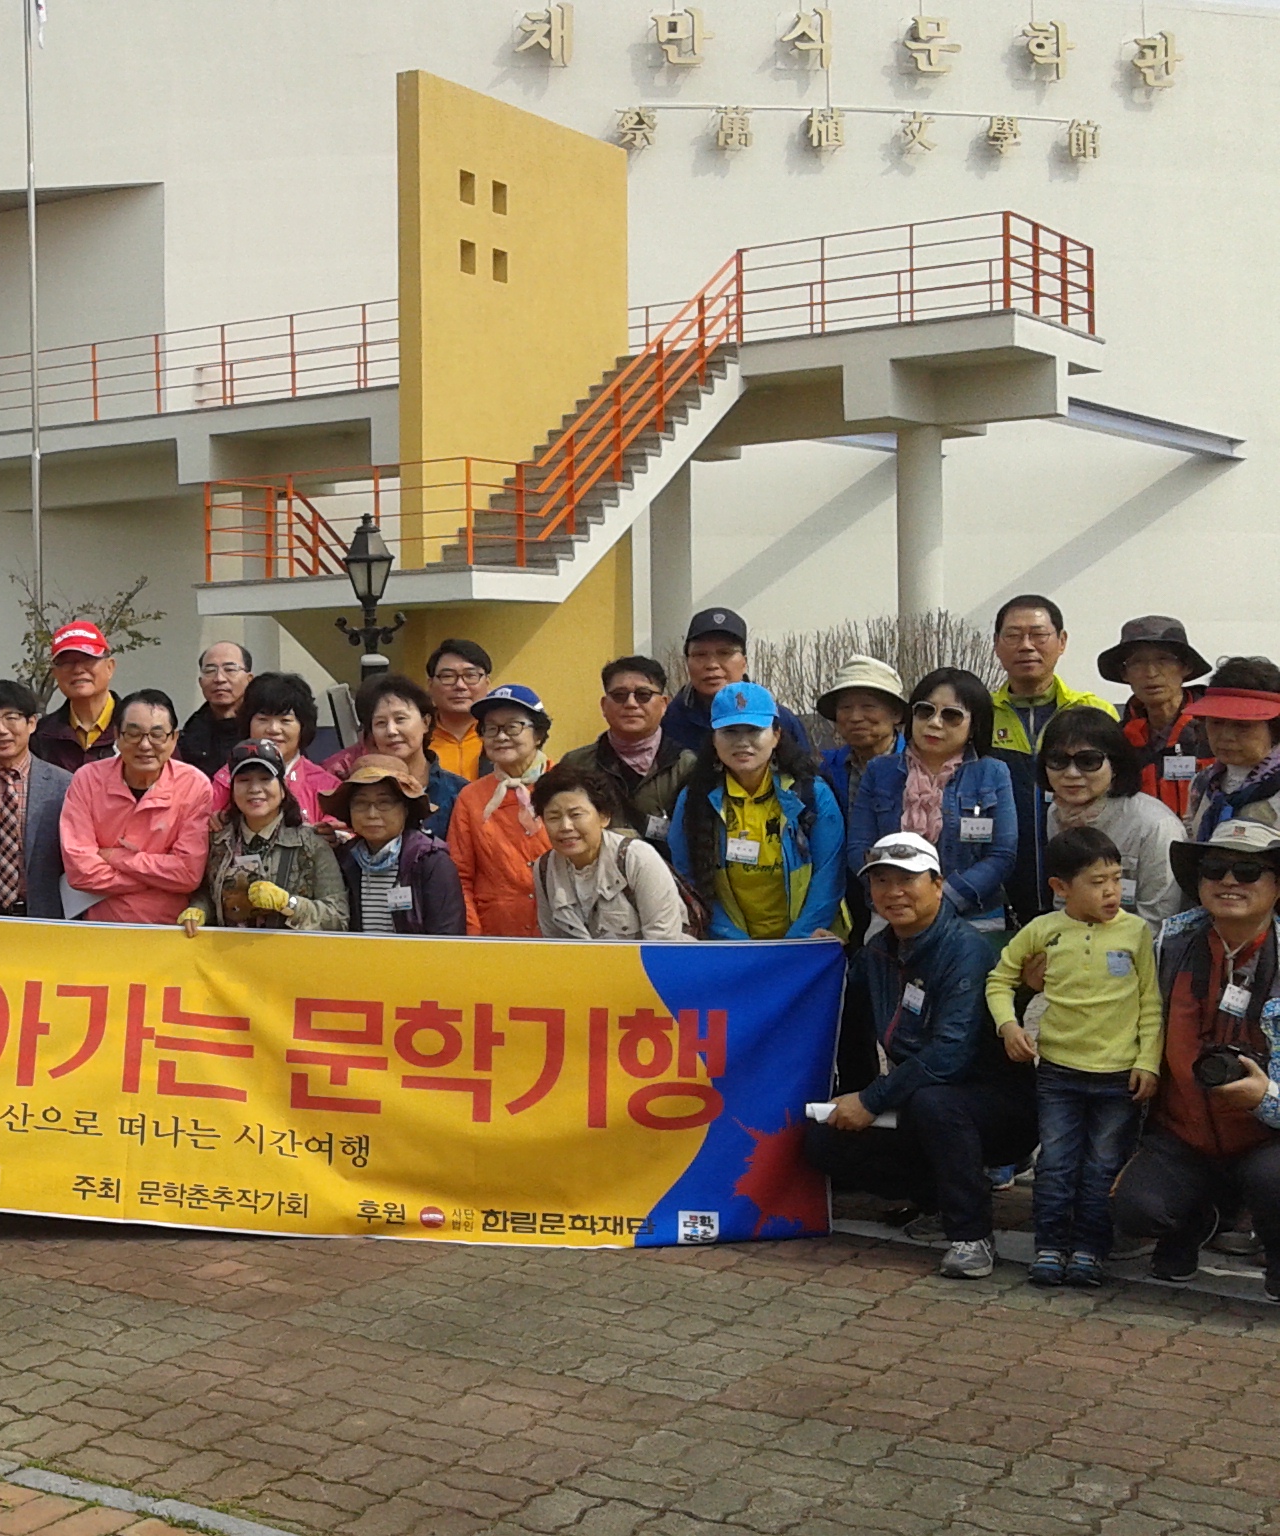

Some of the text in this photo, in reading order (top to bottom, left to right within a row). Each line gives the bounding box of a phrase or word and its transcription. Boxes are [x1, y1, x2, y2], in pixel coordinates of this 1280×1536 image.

[515, 3, 1184, 88] 채만식문학관
[285, 997, 728, 1131] 문학기행
[117, 1112, 222, 1150] 떠나는
[234, 1122, 372, 1170] 시간여행
[71, 1173, 309, 1219] 주최 문학춘추작가회
[356, 1198, 407, 1228] 후원
